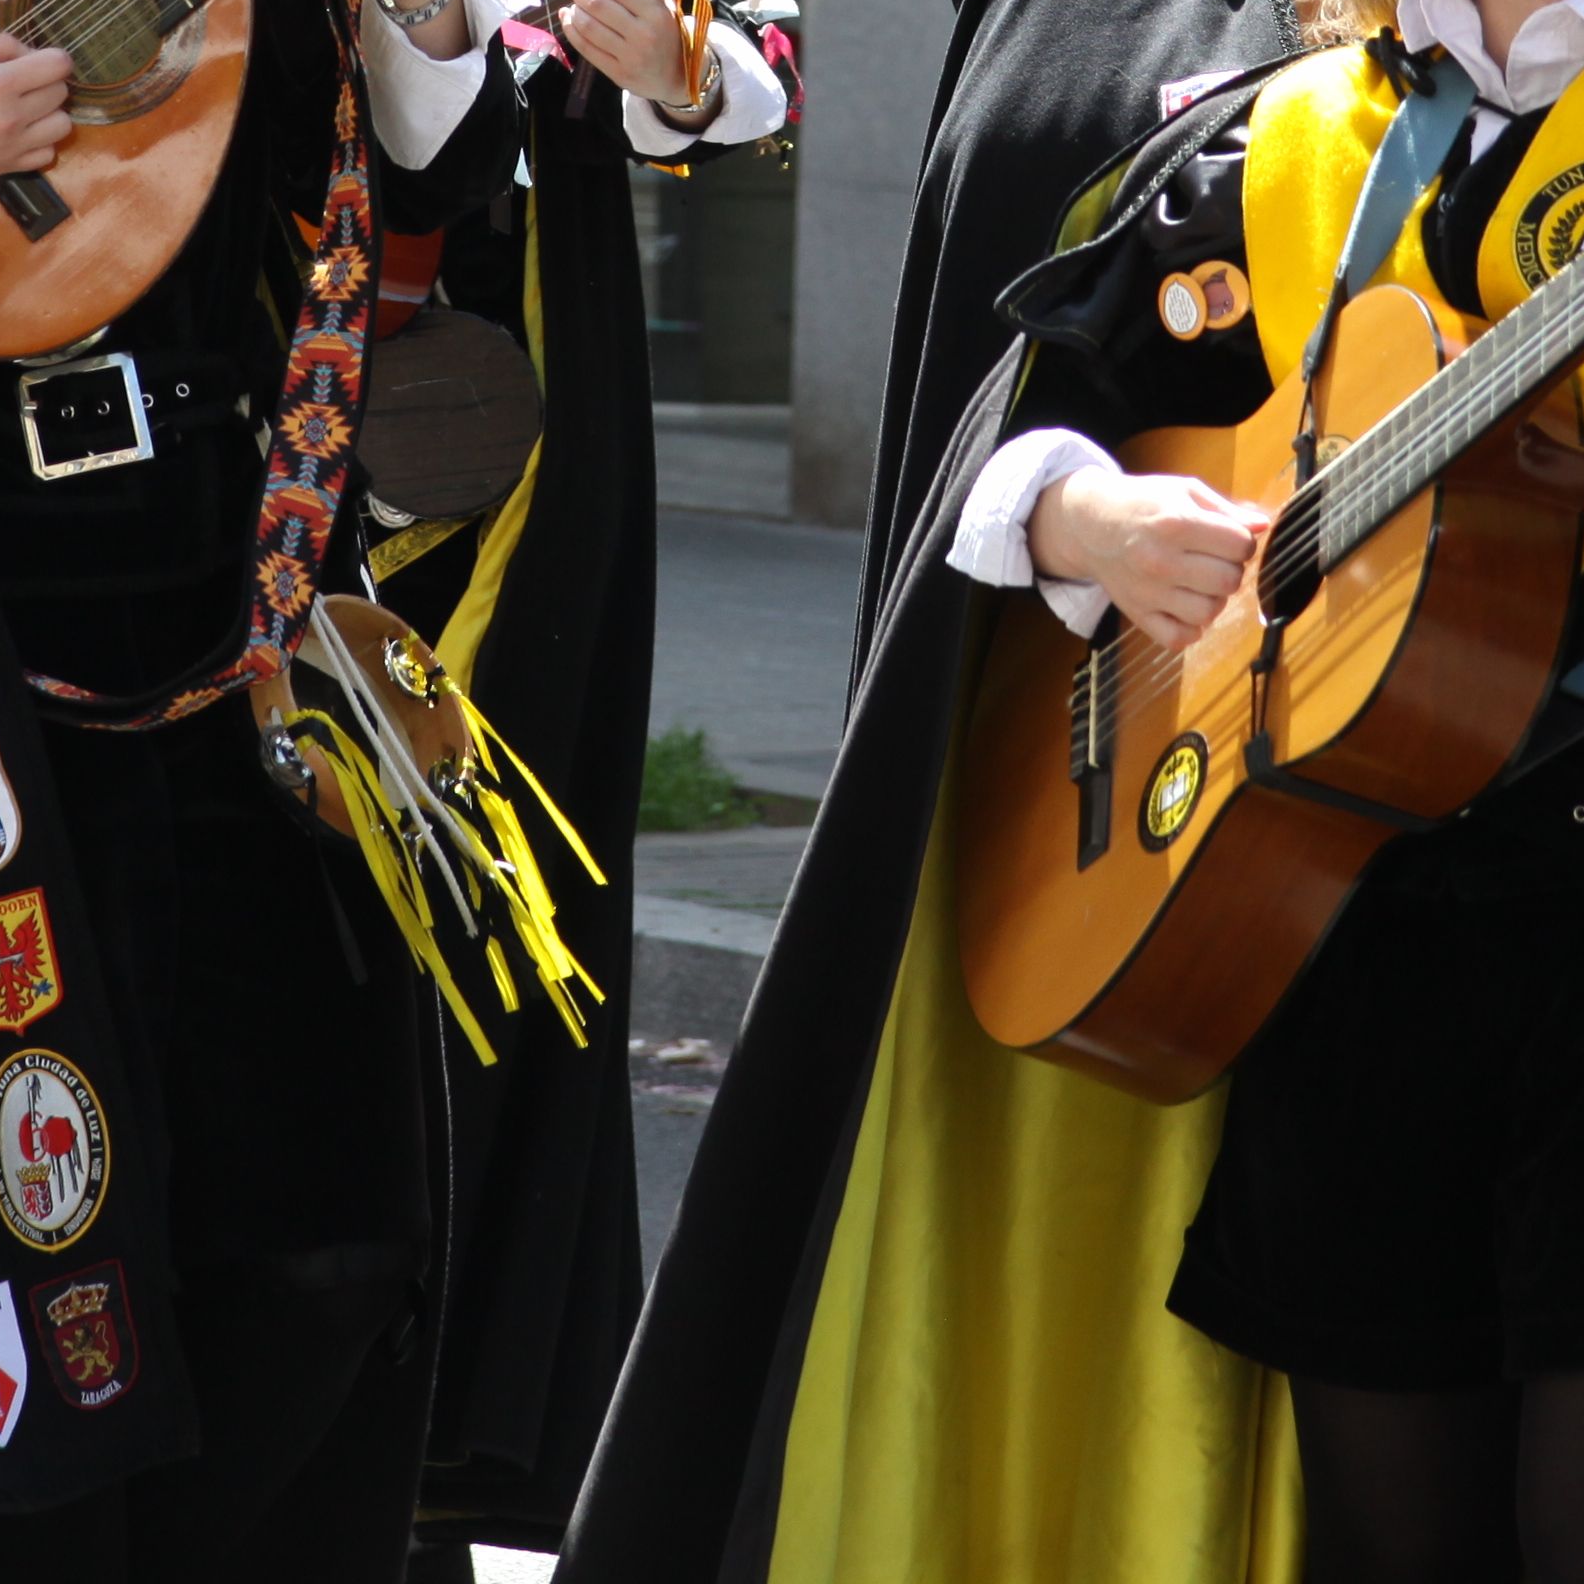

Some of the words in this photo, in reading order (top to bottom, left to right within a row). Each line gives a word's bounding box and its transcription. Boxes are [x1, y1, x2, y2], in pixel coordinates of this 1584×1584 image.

[25, 1054, 79, 1087] Ciudad
[75, 1087, 91, 1109] de
[86, 1108, 102, 1144] Luz
[79, 1378, 123, 1406] ZARAGOZA
